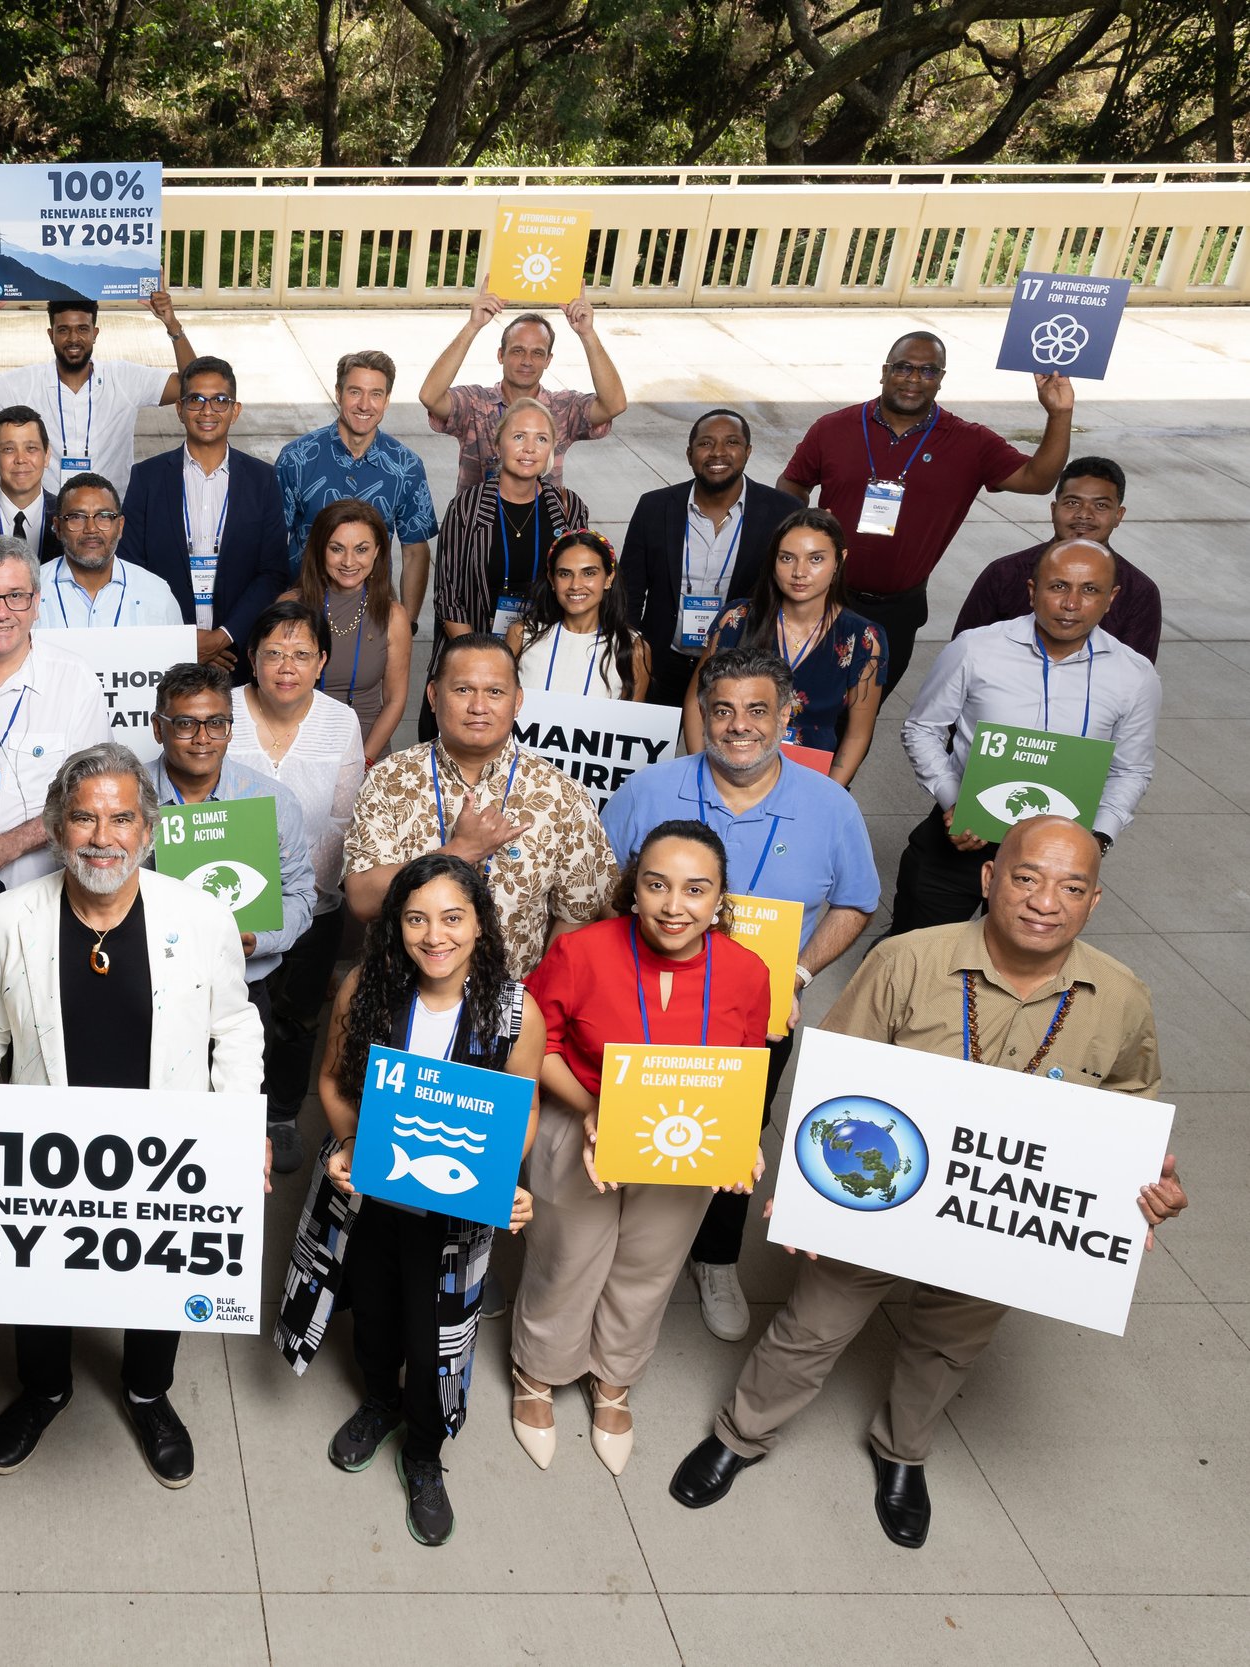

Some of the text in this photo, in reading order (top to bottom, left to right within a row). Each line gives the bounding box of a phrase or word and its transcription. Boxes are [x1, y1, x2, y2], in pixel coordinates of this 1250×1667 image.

[48, 170, 144, 201] 100%
[41, 208, 153, 219] RENEWABLE ENERGY
[503, 212, 513, 232] 7
[519, 213, 577, 224] AFFORDABLE AND
[42, 223, 153, 246] BY 2045!
[518, 225, 566, 235] CLEAN ENERGY
[1021, 279, 1043, 300] 17
[1050, 281, 1110, 294] PARTNERSHIPS
[1047, 293, 1107, 306] FOR THE GOALS
[112, 671, 171, 688] HOP
[512, 720, 670, 764] MANITY
[980, 731, 1008, 757] 13
[1016, 736, 1057, 752] CLIMATE
[1012, 751, 1048, 765] ACTION
[192, 811, 228, 825] CLIMATE
[161, 815, 185, 845] 13
[194, 828, 225, 842] ACTION
[755, 907, 778, 920] AND
[733, 922, 761, 935] ERGY
[615, 1055, 631, 1084] 7
[642, 1056, 742, 1071] AFFORDABLE AND
[375, 1058, 405, 1094] 14
[417, 1067, 441, 1084] LIFE
[641, 1073, 724, 1088] CLEAN ENERGY
[414, 1085, 494, 1115] BELOW WATER
[951, 1126, 1047, 1172] BLUE
[946, 1160, 1097, 1218] PLANET
[136, 1202, 244, 1224] ENERGY
[935, 1195, 1132, 1265] ALLIANCE
[63, 1226, 244, 1277] 2045!
[216, 1314, 254, 1322] ALLIANCE
